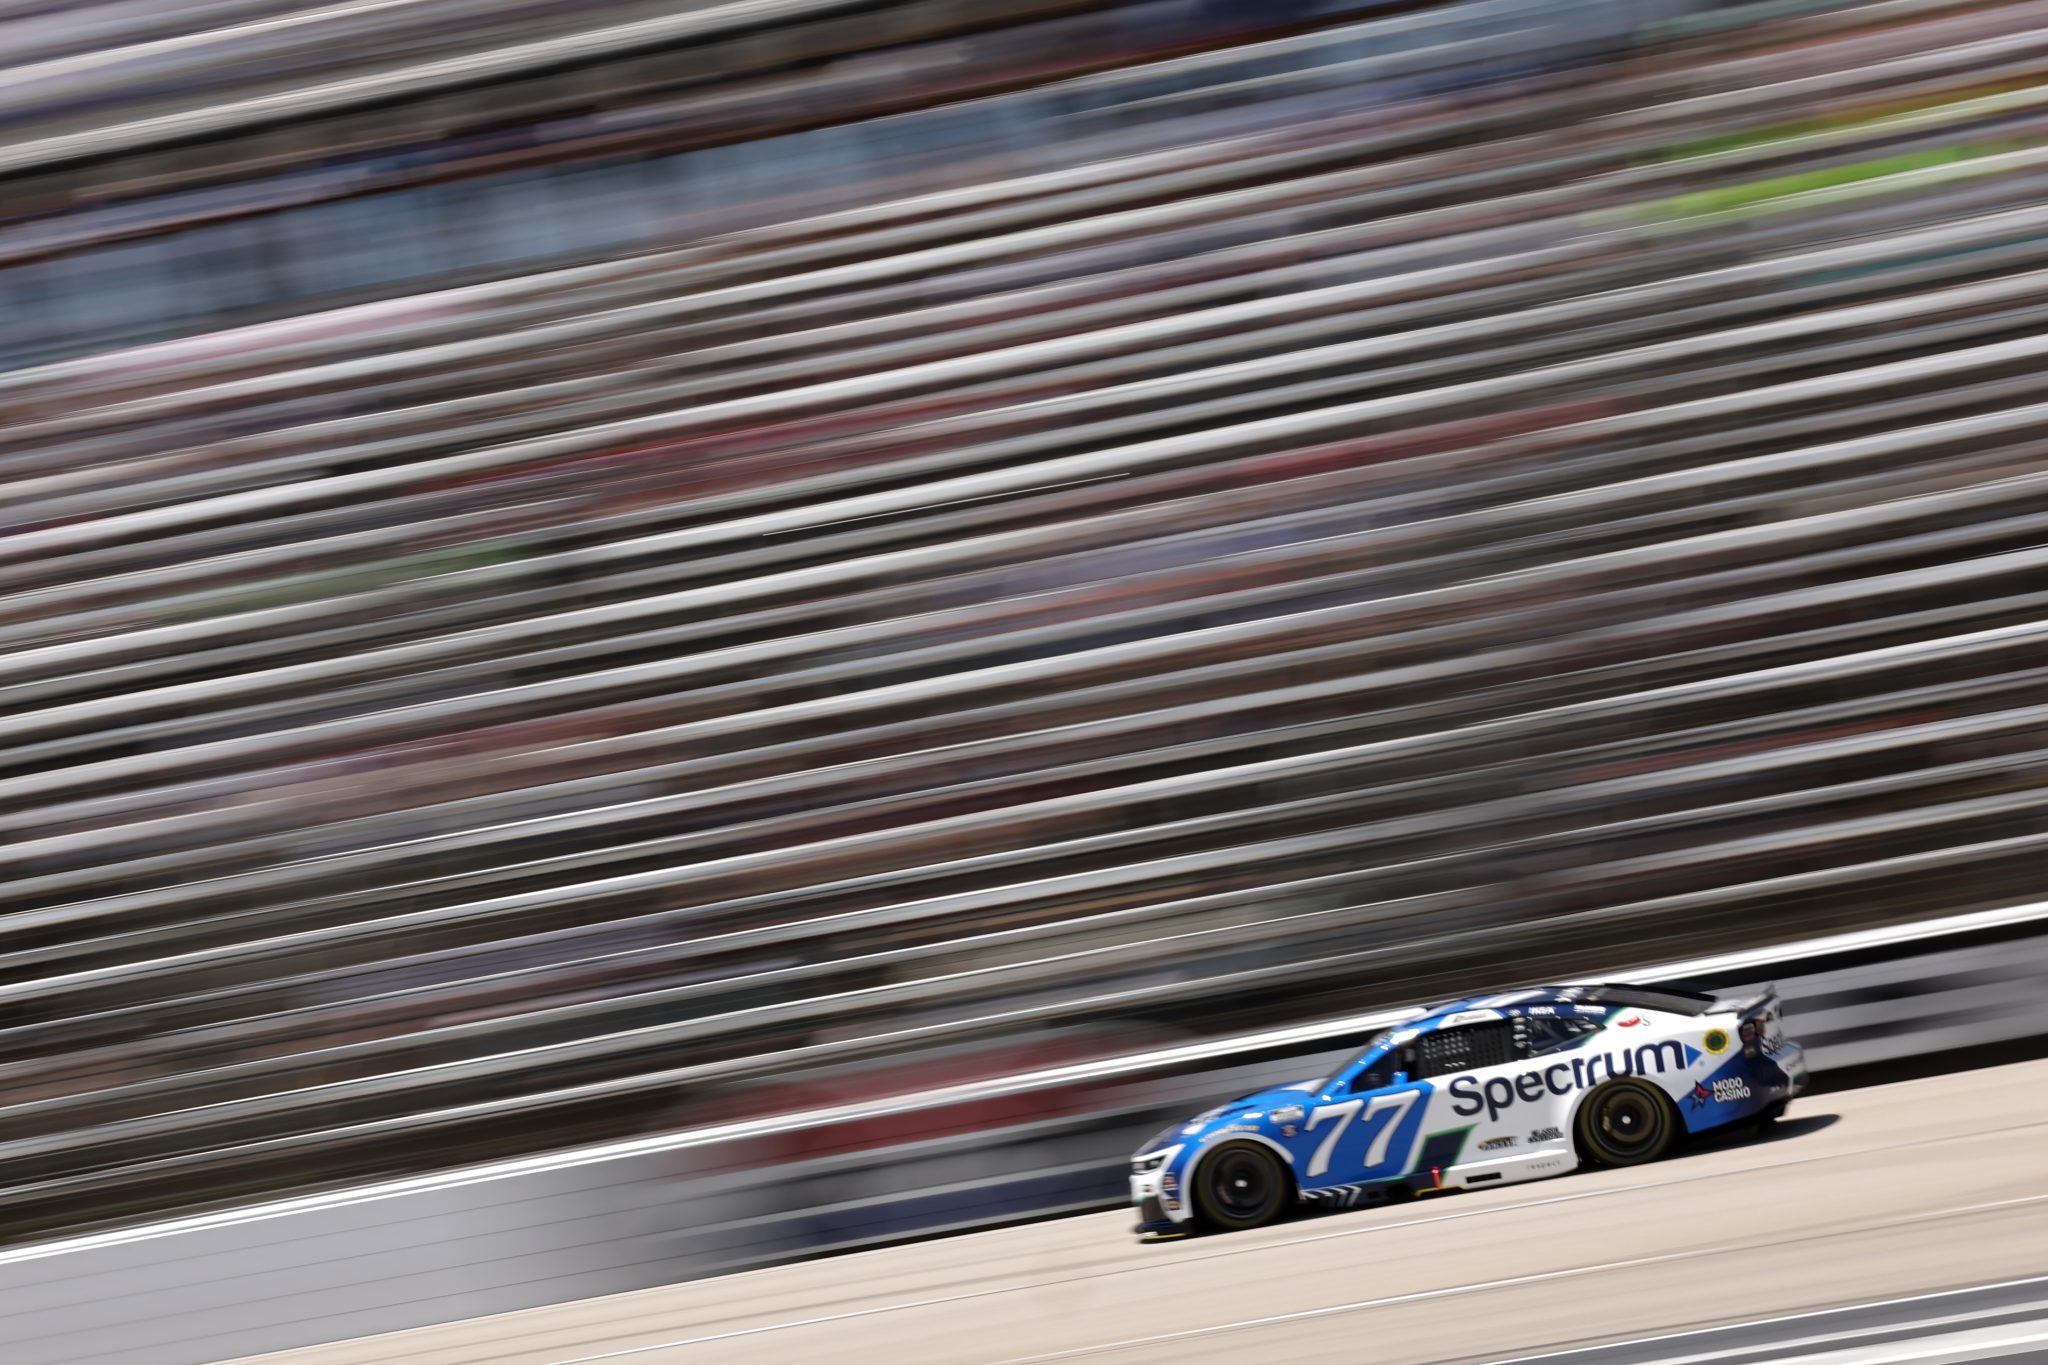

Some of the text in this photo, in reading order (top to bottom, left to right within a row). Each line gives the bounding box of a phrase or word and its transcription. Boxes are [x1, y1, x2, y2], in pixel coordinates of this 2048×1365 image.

[1449, 1040, 1685, 1122] Spectrum
[1712, 1076, 1744, 1092] MODO
[1714, 1086, 1751, 1103] CASINO
[1304, 1089, 1421, 1178] 77
